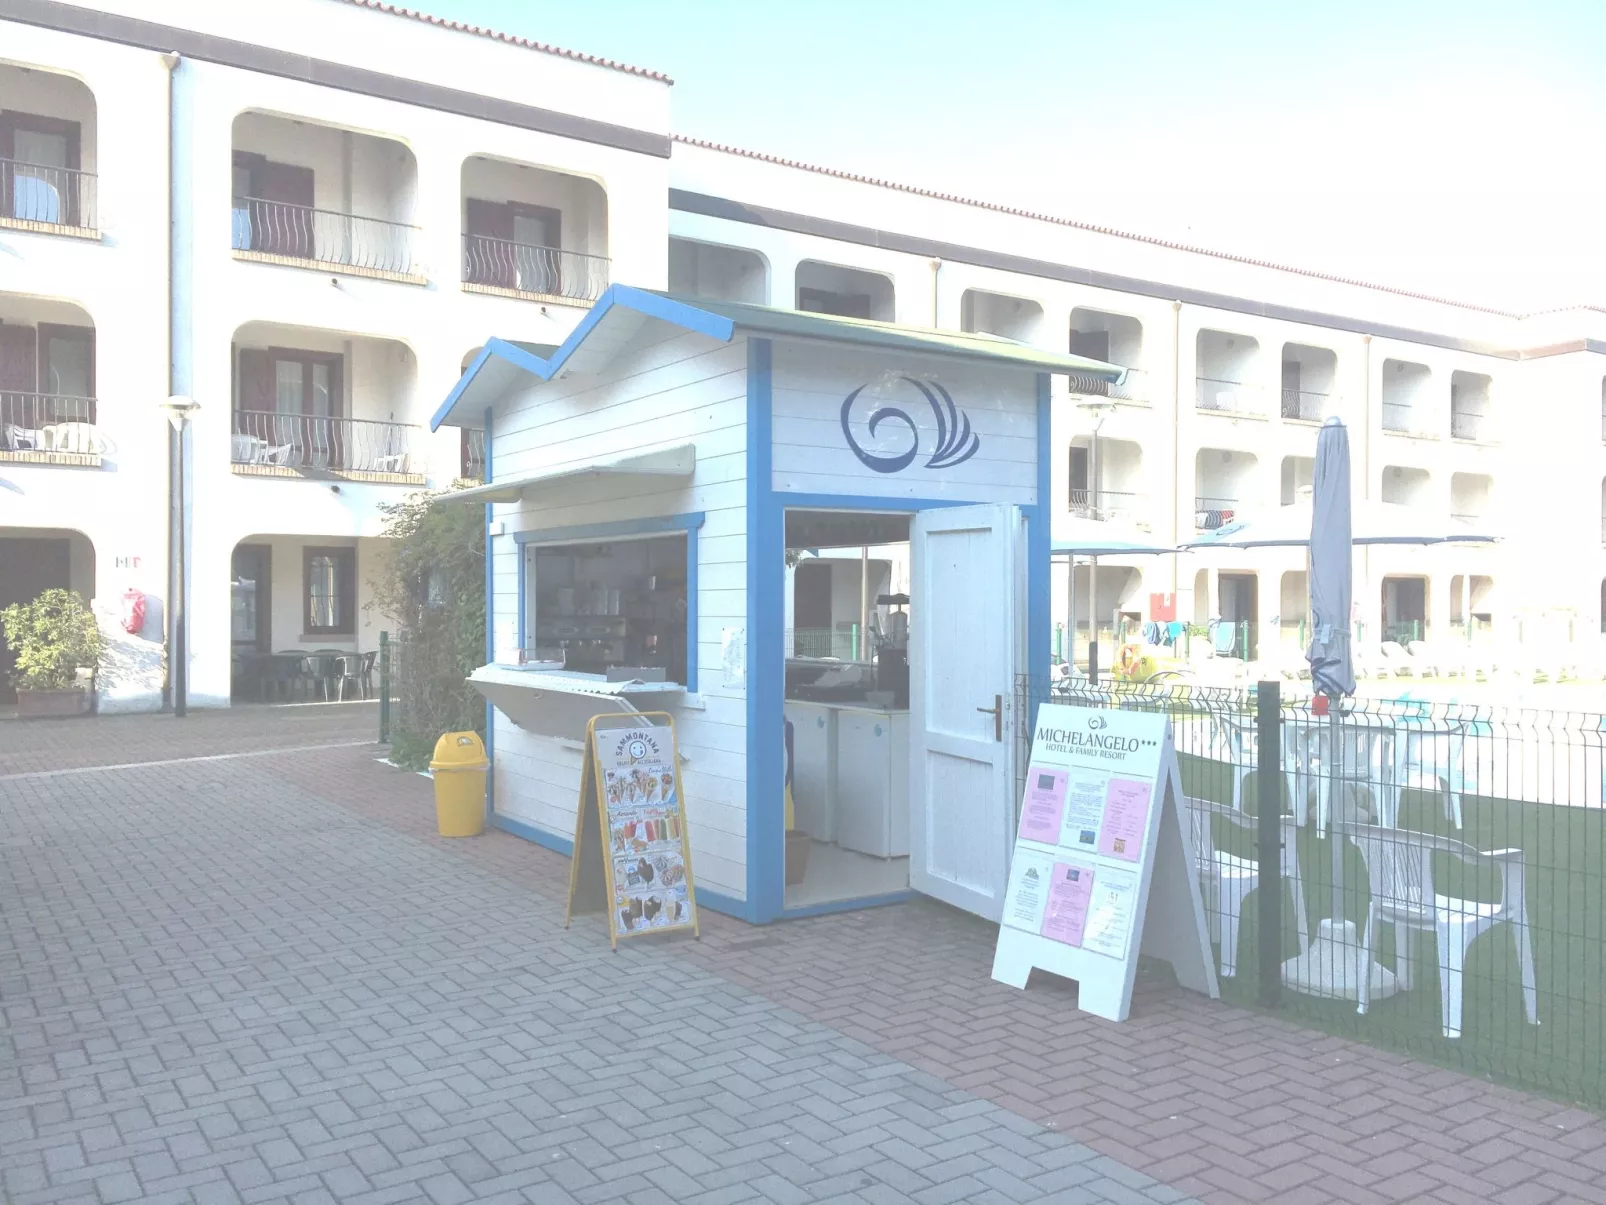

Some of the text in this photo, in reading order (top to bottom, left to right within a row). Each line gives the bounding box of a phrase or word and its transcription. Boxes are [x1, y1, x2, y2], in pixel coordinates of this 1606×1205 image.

[616, 732, 659, 756] SAMMONTANA
[1036, 728, 1139, 752] MICHELANGELO
[1046, 743, 1067, 752] HOTEL
[1076, 747, 1098, 756] FAMILY
[1100, 750, 1126, 760] RESORT
